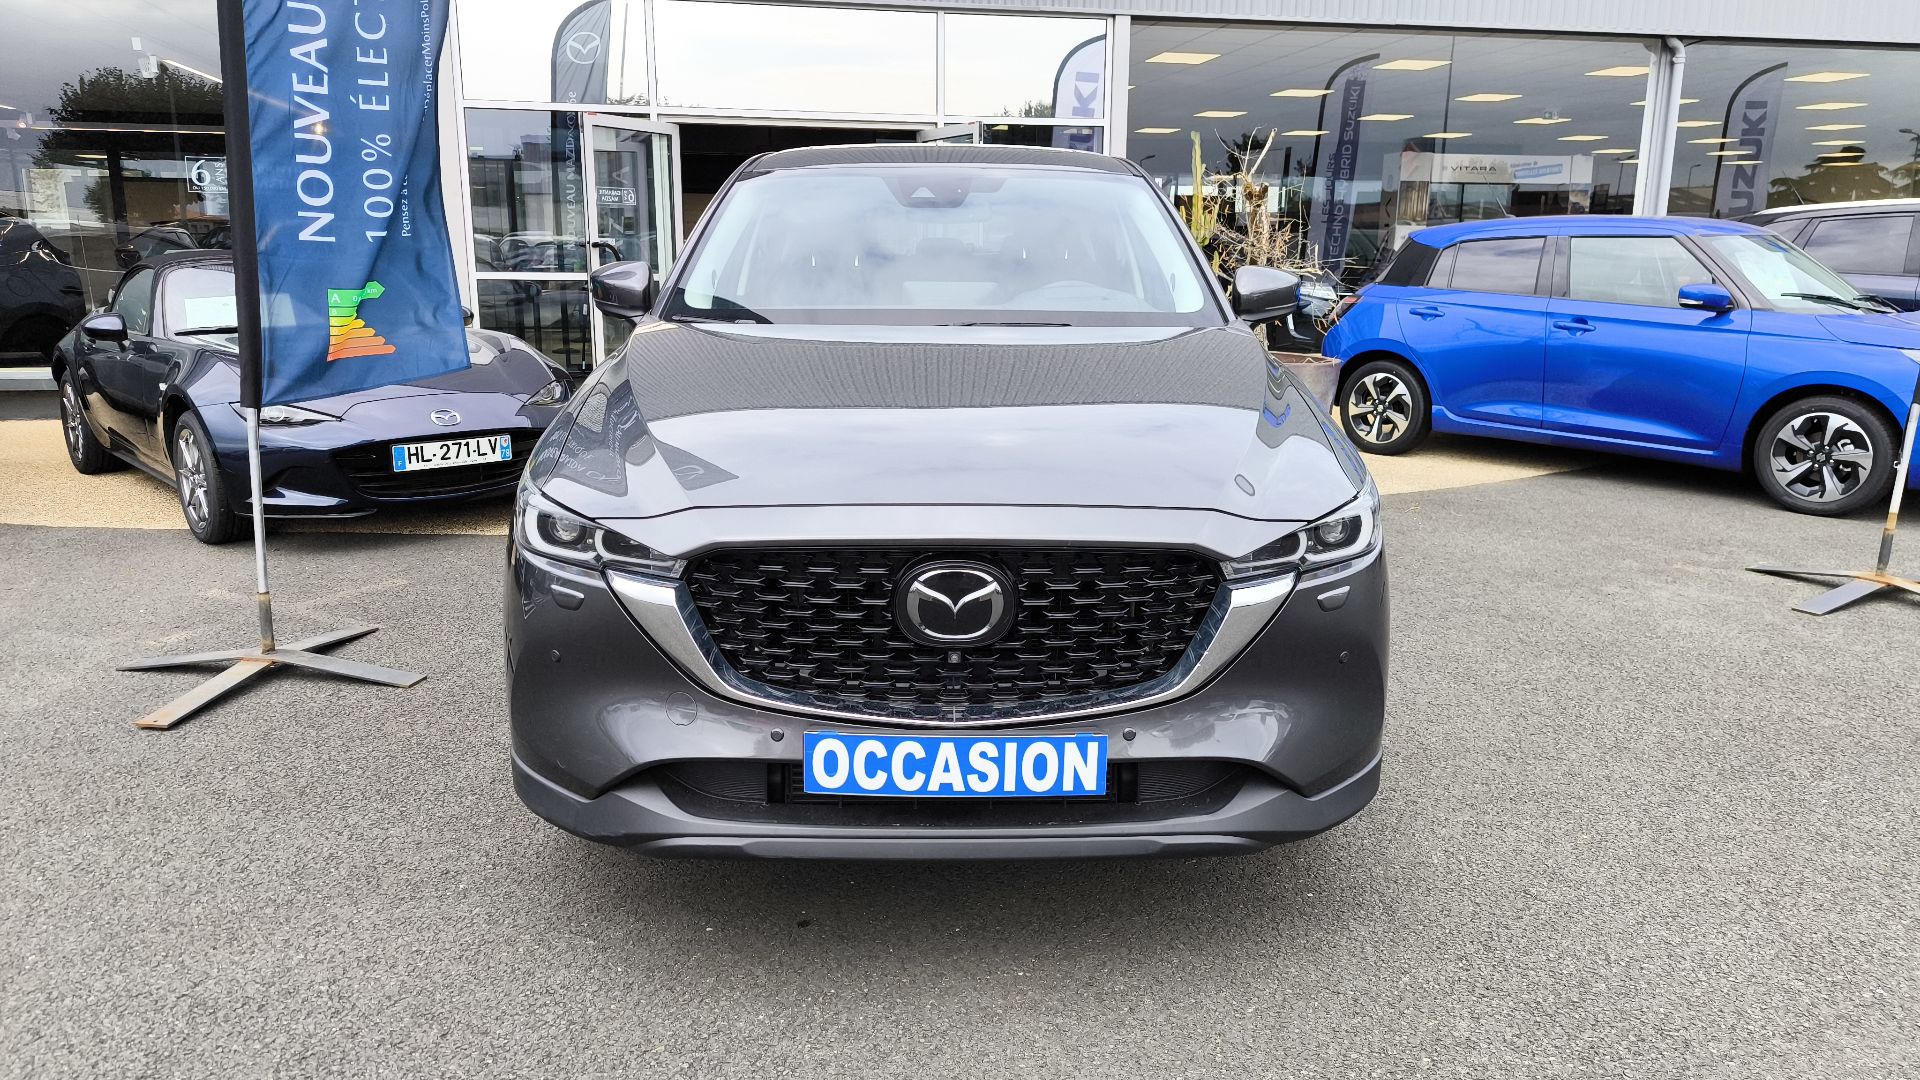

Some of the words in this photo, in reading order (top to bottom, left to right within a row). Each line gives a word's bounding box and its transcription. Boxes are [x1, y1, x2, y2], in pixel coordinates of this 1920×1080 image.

[350, 0, 390, 110] ÉLEC
[287, 1, 336, 242] NOUVEAU
[1343, 86, 1361, 141] SUZUKI
[191, 159, 210, 186] 6
[361, 134, 395, 242] 100%
[331, 294, 341, 304] A
[407, 437, 498, 464] HL-271-LV
[812, 738, 1099, 793] OCCASION
